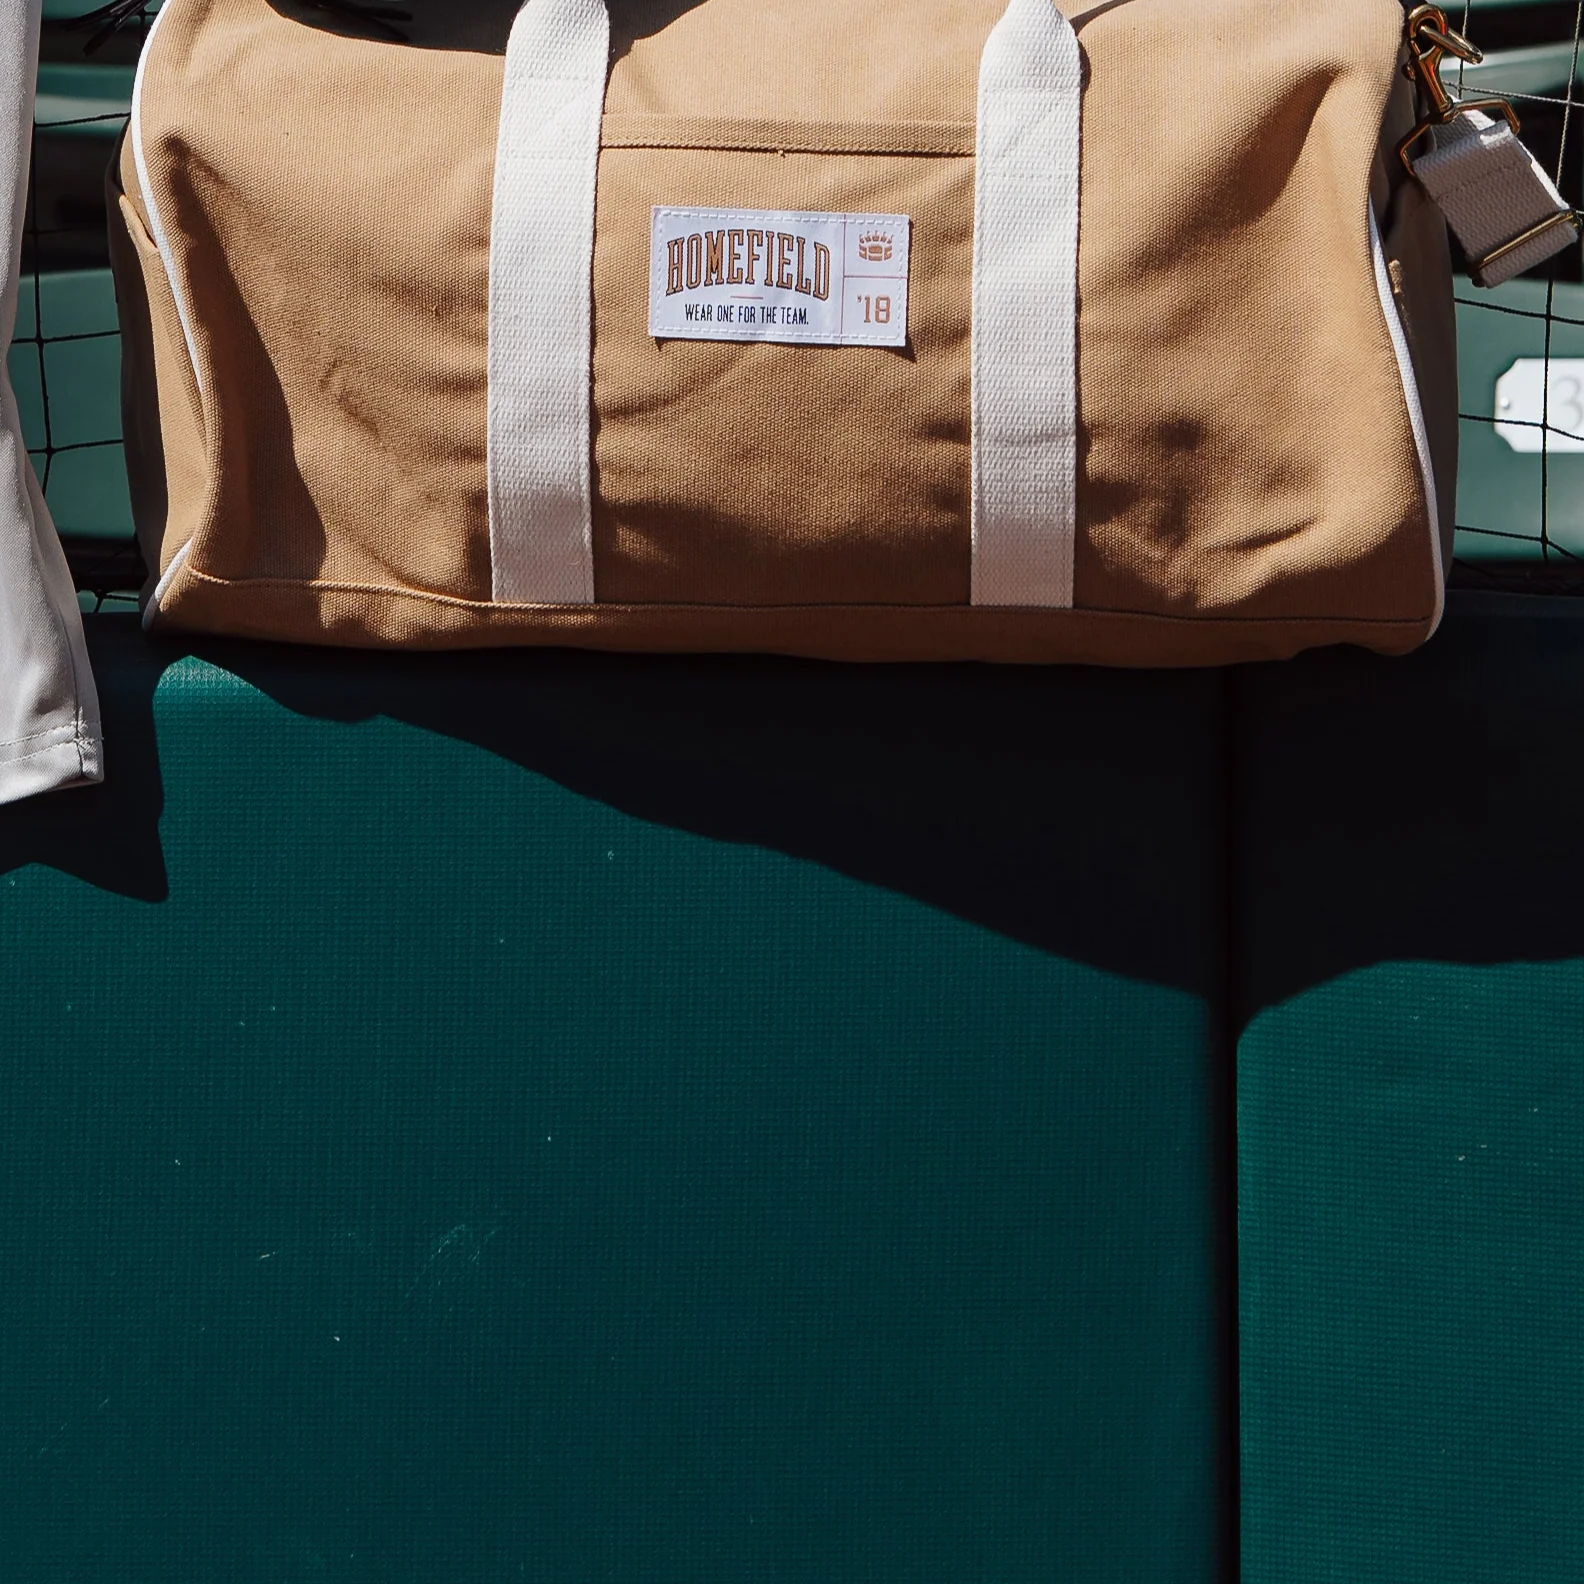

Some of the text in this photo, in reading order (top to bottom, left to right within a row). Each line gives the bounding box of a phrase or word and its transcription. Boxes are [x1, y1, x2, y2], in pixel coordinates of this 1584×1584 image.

[666, 229, 831, 302] HOMEFIELD
[685, 304, 809, 325] WEAR ONE FOR THE TEAM.
